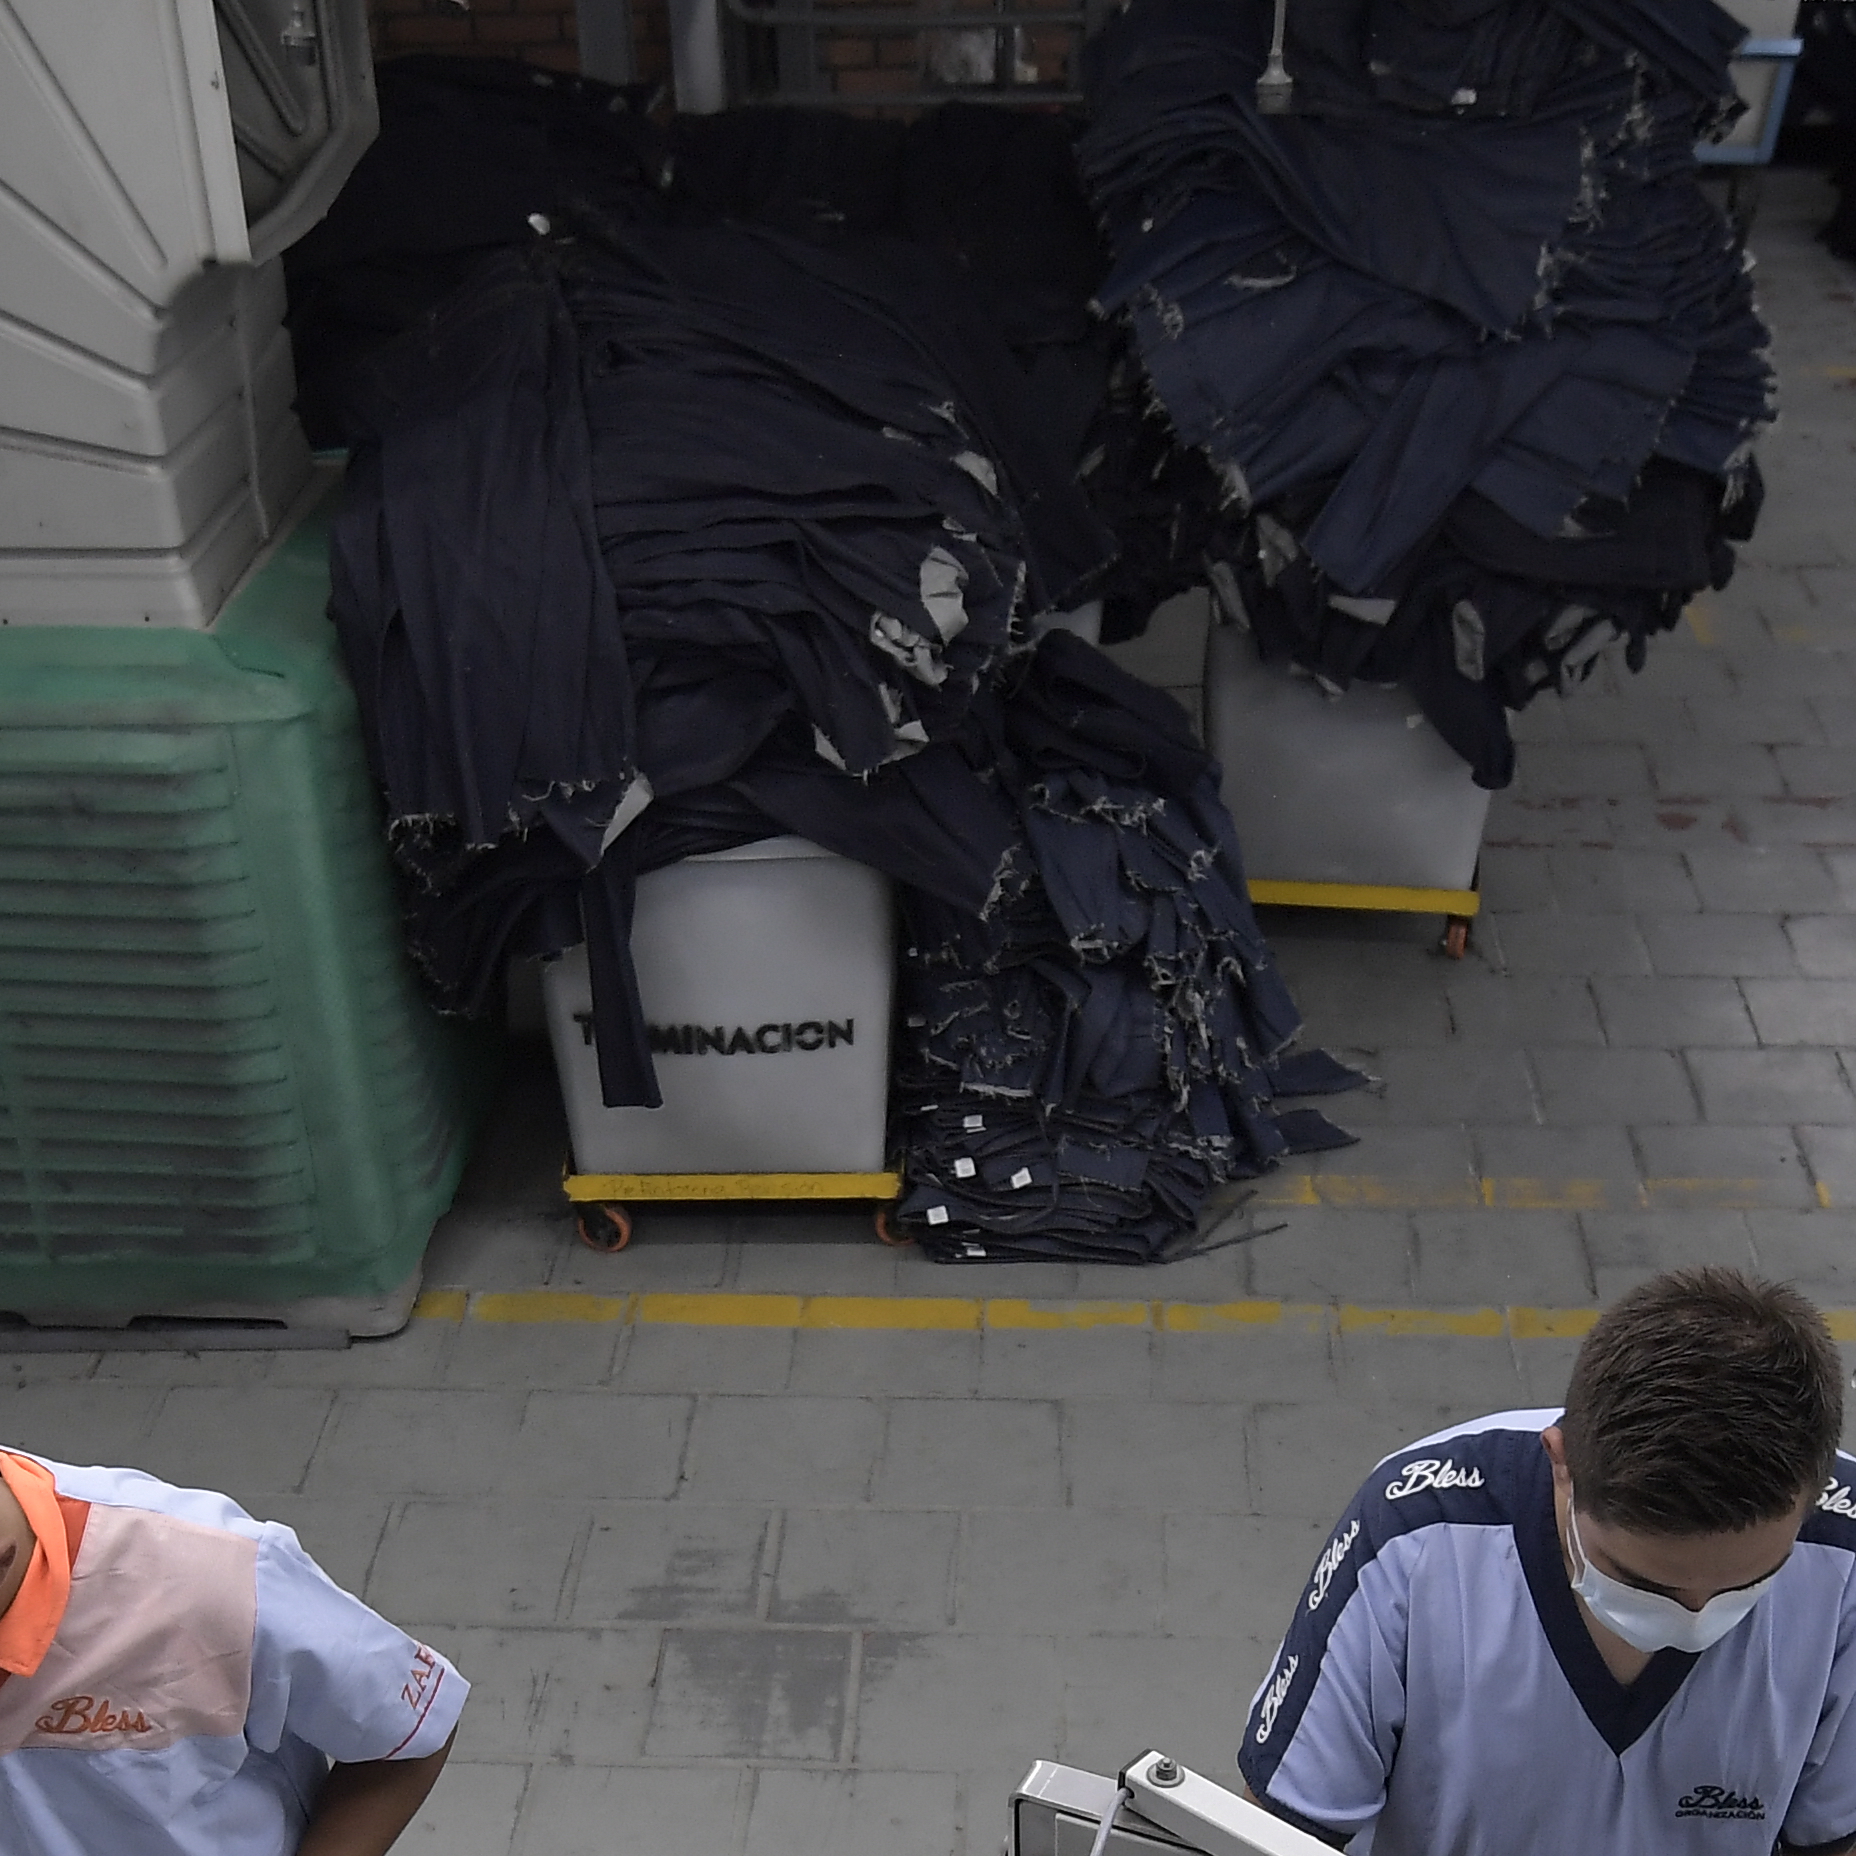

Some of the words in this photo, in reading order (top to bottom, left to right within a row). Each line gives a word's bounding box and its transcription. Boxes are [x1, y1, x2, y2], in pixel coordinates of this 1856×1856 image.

[573, 1012, 854, 1055] TMINACION
[1385, 1458, 1485, 1500] Bless
[1308, 1519, 1360, 1611] Bless
[35, 1696, 152, 1733] Bless
[1256, 1654, 1299, 1744] Bless
[1678, 1785, 1763, 1810] Bless
